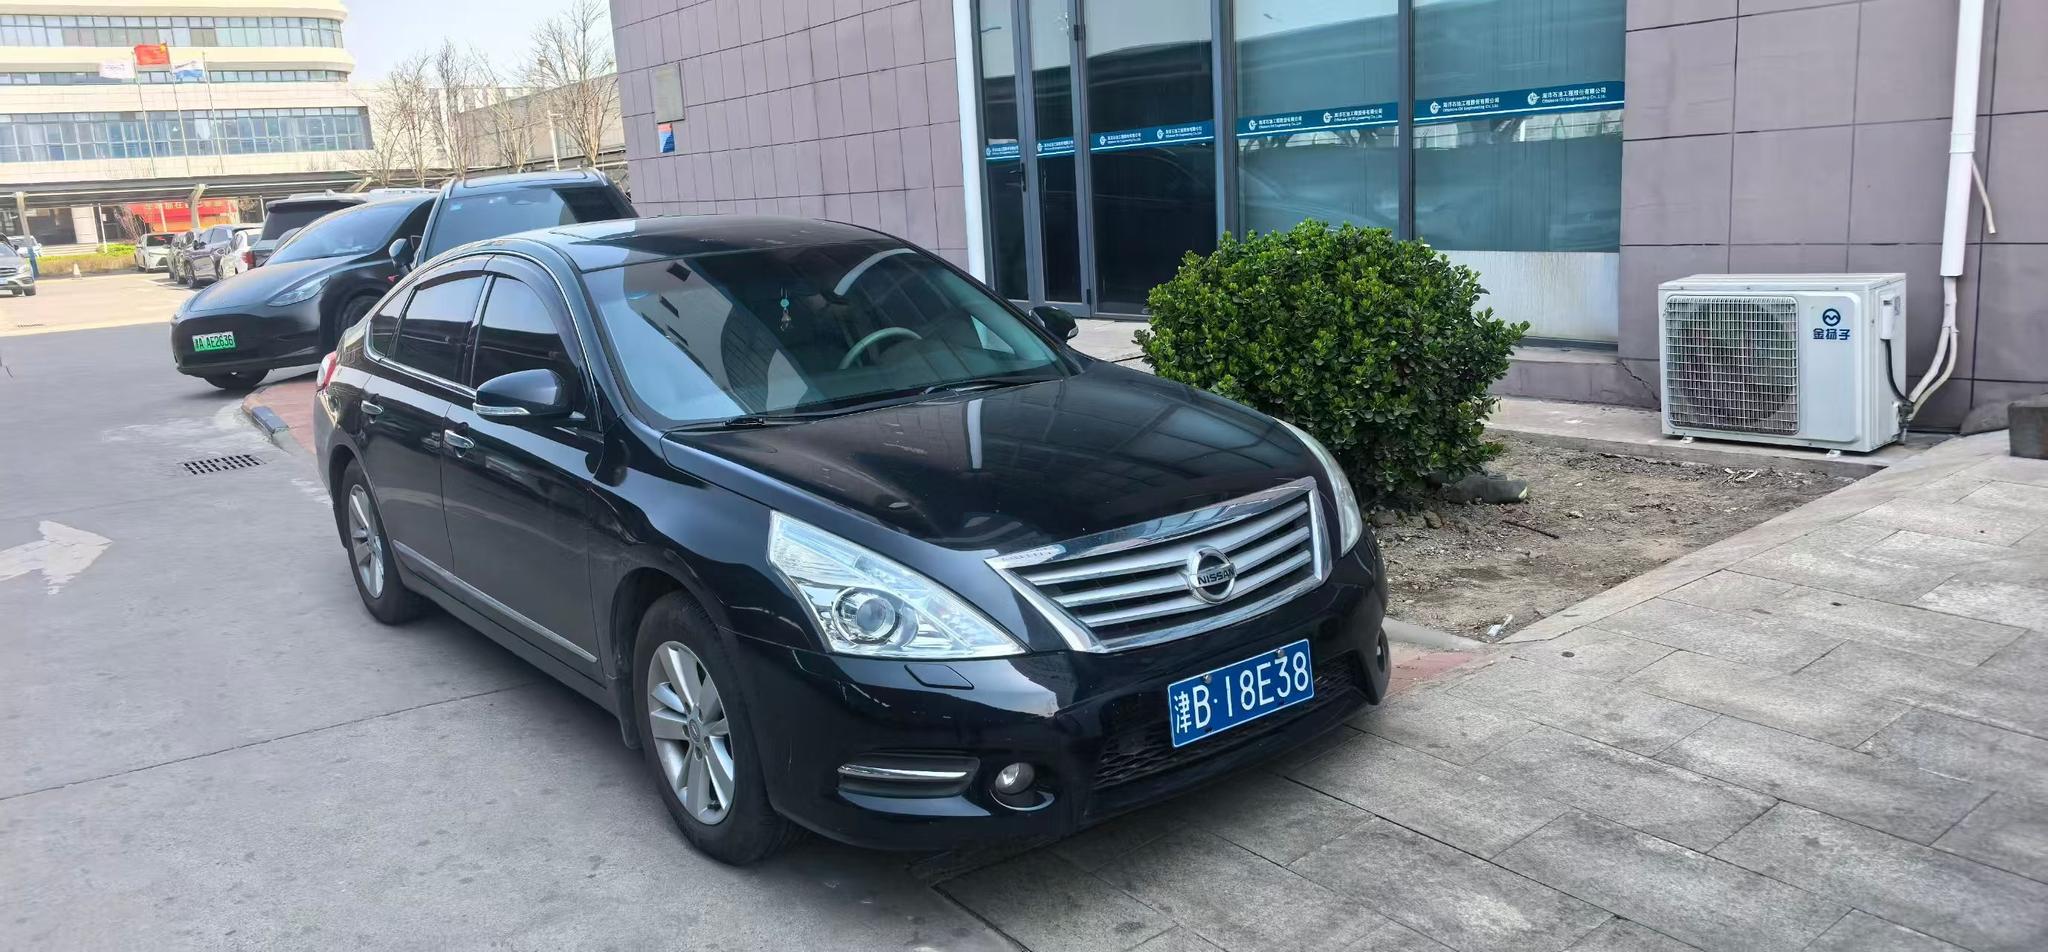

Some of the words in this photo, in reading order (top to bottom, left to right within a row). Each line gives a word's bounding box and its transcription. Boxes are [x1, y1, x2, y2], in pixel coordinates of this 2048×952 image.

[1813, 328, 1850, 340] 金扬子
[1198, 568, 1235, 584] NISSAN
